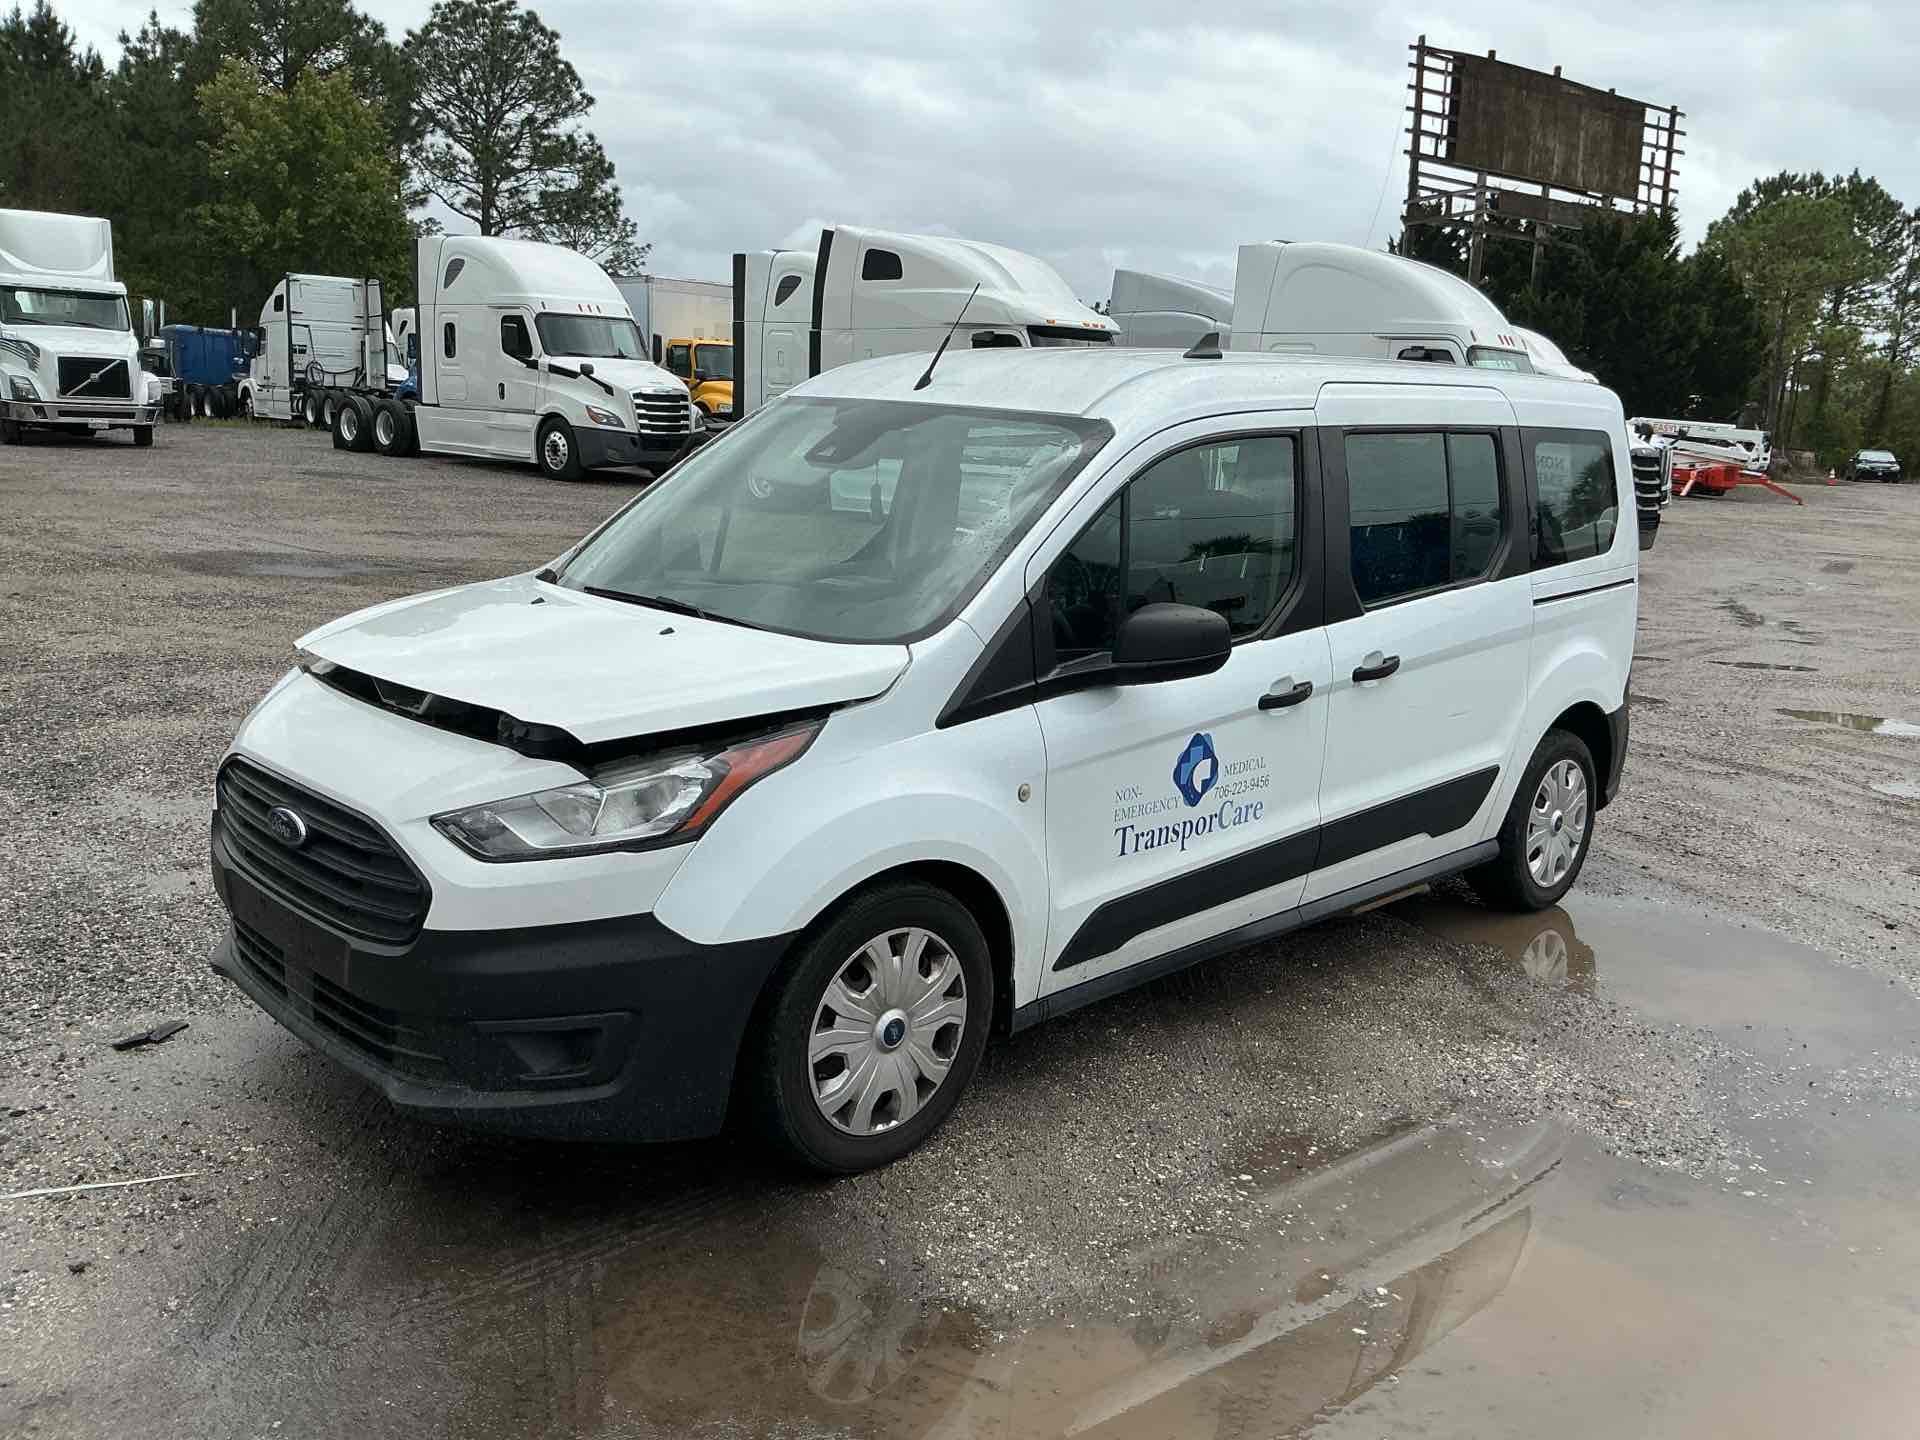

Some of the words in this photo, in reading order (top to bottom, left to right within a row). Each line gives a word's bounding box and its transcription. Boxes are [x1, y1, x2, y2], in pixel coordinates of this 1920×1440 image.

[1224, 756, 1266, 776] MEDICAL
[1115, 786, 1143, 801] NON-
[1214, 774, 1270, 799] 706-223-9456
[1114, 796, 1182, 822] EMERGENCY
[1114, 800, 1264, 857] TransporCare
